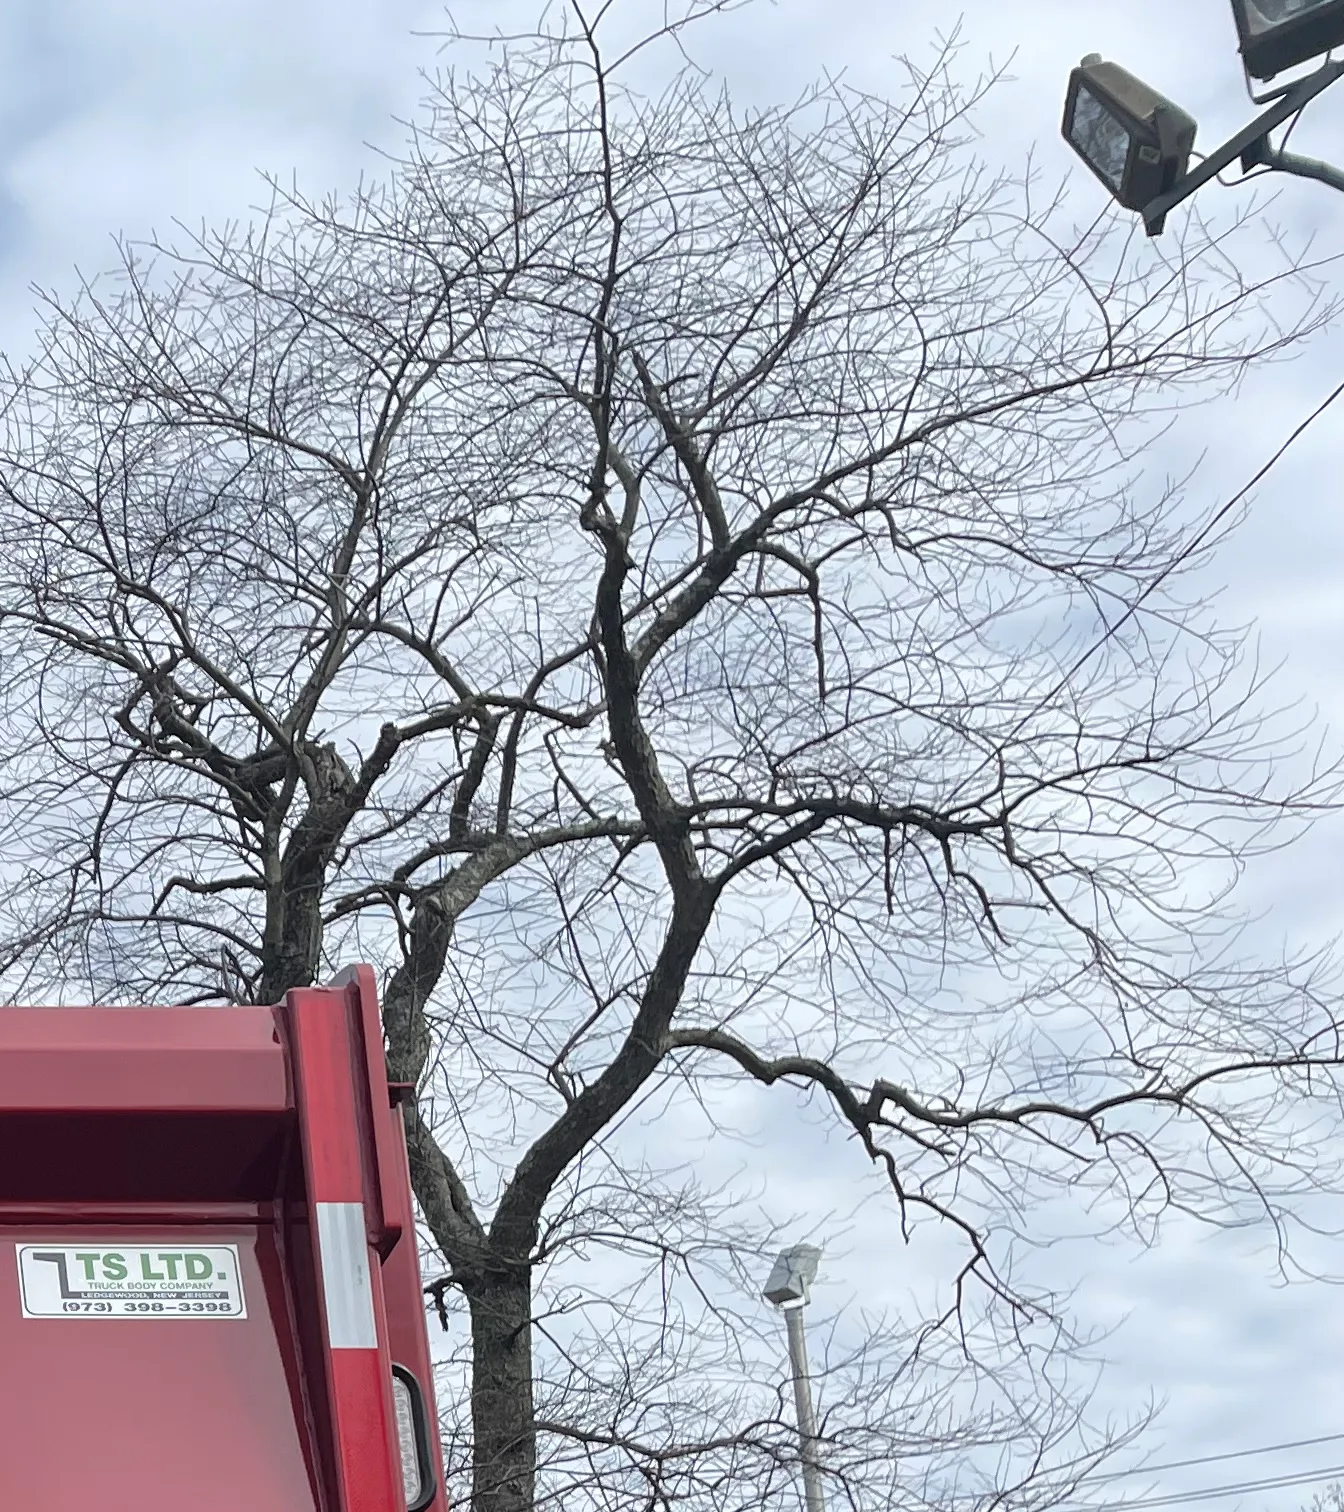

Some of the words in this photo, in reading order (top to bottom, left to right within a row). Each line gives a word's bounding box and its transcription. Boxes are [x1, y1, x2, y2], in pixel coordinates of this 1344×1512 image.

[140, 1253, 226, 1281] LTD.
[88, 1282, 125, 1290] TRUCK
[127, 1282, 157, 1290] BODY
[159, 1282, 214, 1290] COMPANY
[63, 1302, 113, 1312] (973)
[124, 1302, 232, 1312] 398-3398
